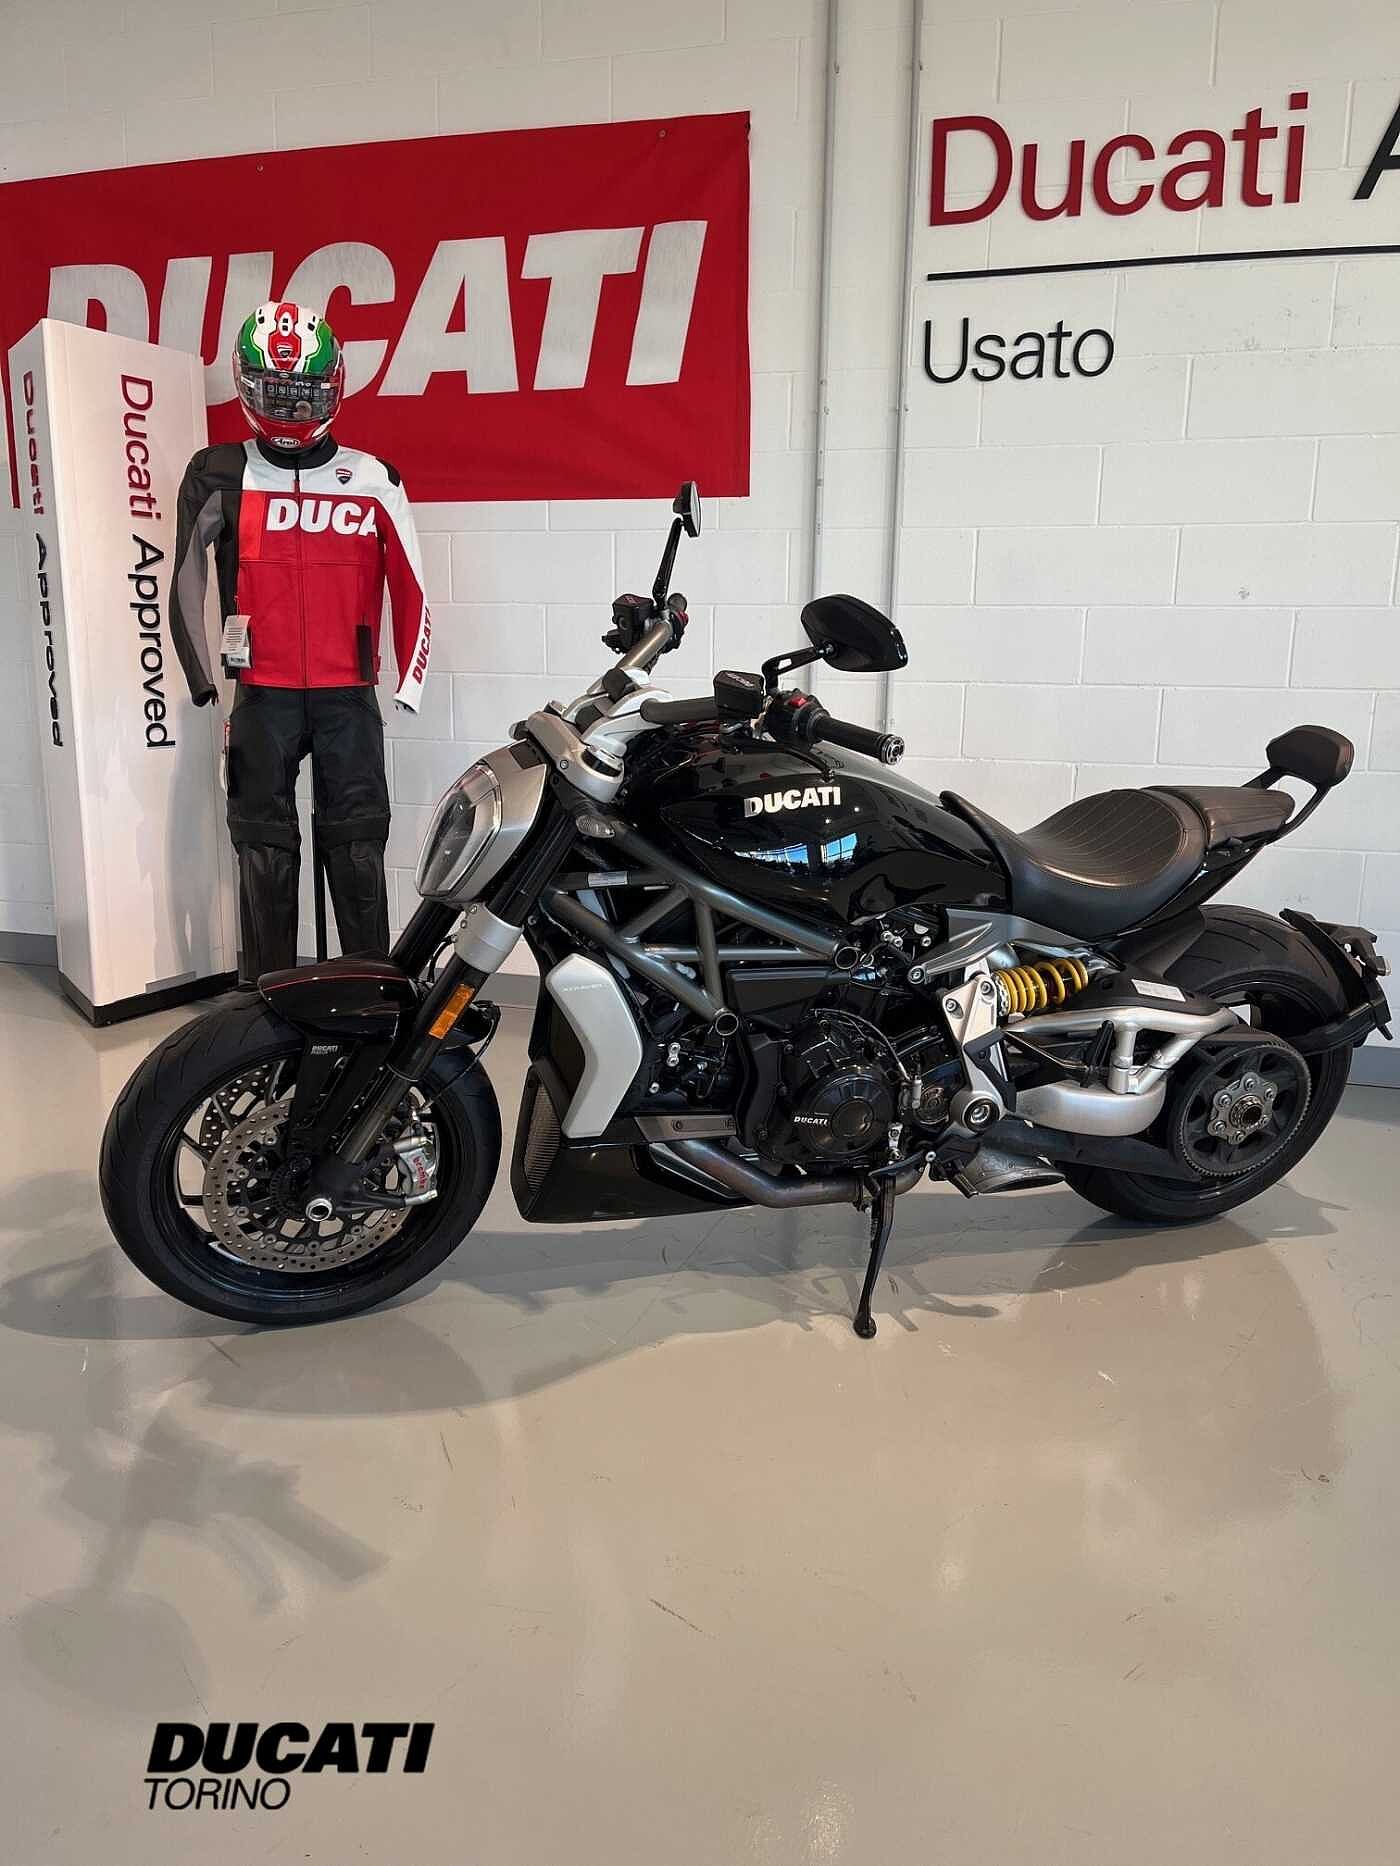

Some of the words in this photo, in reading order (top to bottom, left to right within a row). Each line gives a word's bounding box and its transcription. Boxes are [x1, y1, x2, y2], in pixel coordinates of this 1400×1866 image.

[928, 91, 1309, 227] Ducati
[923, 317, 1116, 385] Usato
[120, 373, 161, 521] Ducati
[22, 370, 45, 516] Ducati
[35, 532, 64, 748] Approved
[128, 533, 176, 748] Approved
[744, 786, 841, 818] DUCATI
[794, 1116, 828, 1126] DUCATI
